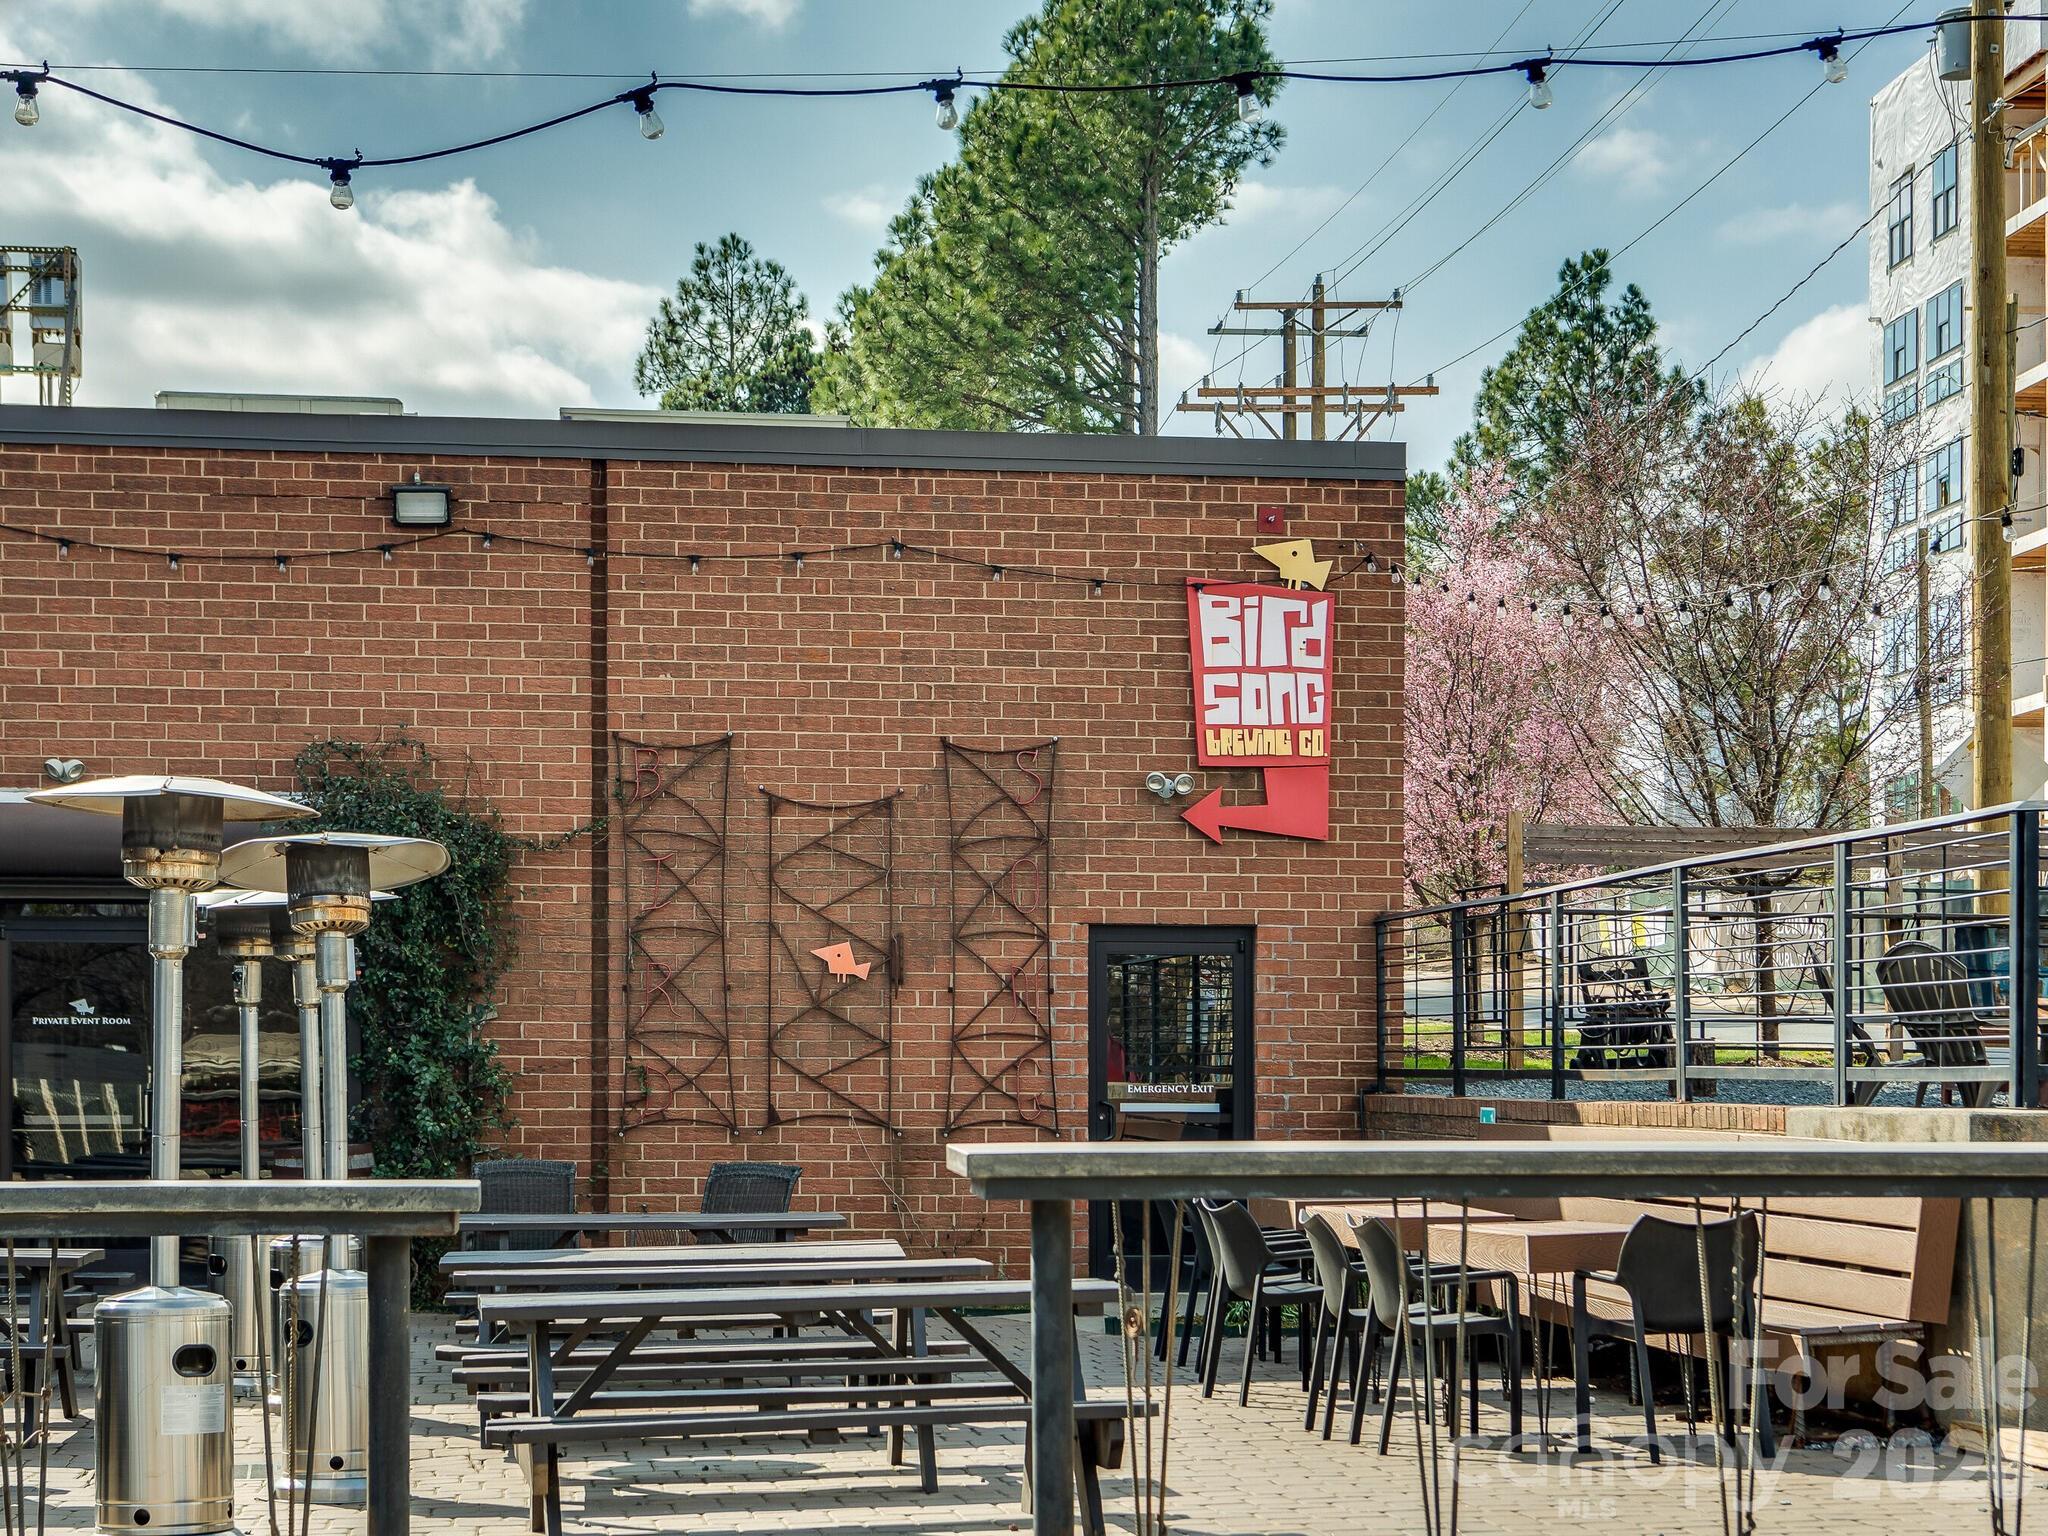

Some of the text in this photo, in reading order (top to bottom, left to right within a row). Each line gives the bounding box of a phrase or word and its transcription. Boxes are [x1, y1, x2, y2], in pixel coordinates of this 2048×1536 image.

[1199, 594, 1328, 668] Bird
[1127, 1084, 1214, 1093] EMERGENCY EXIT
